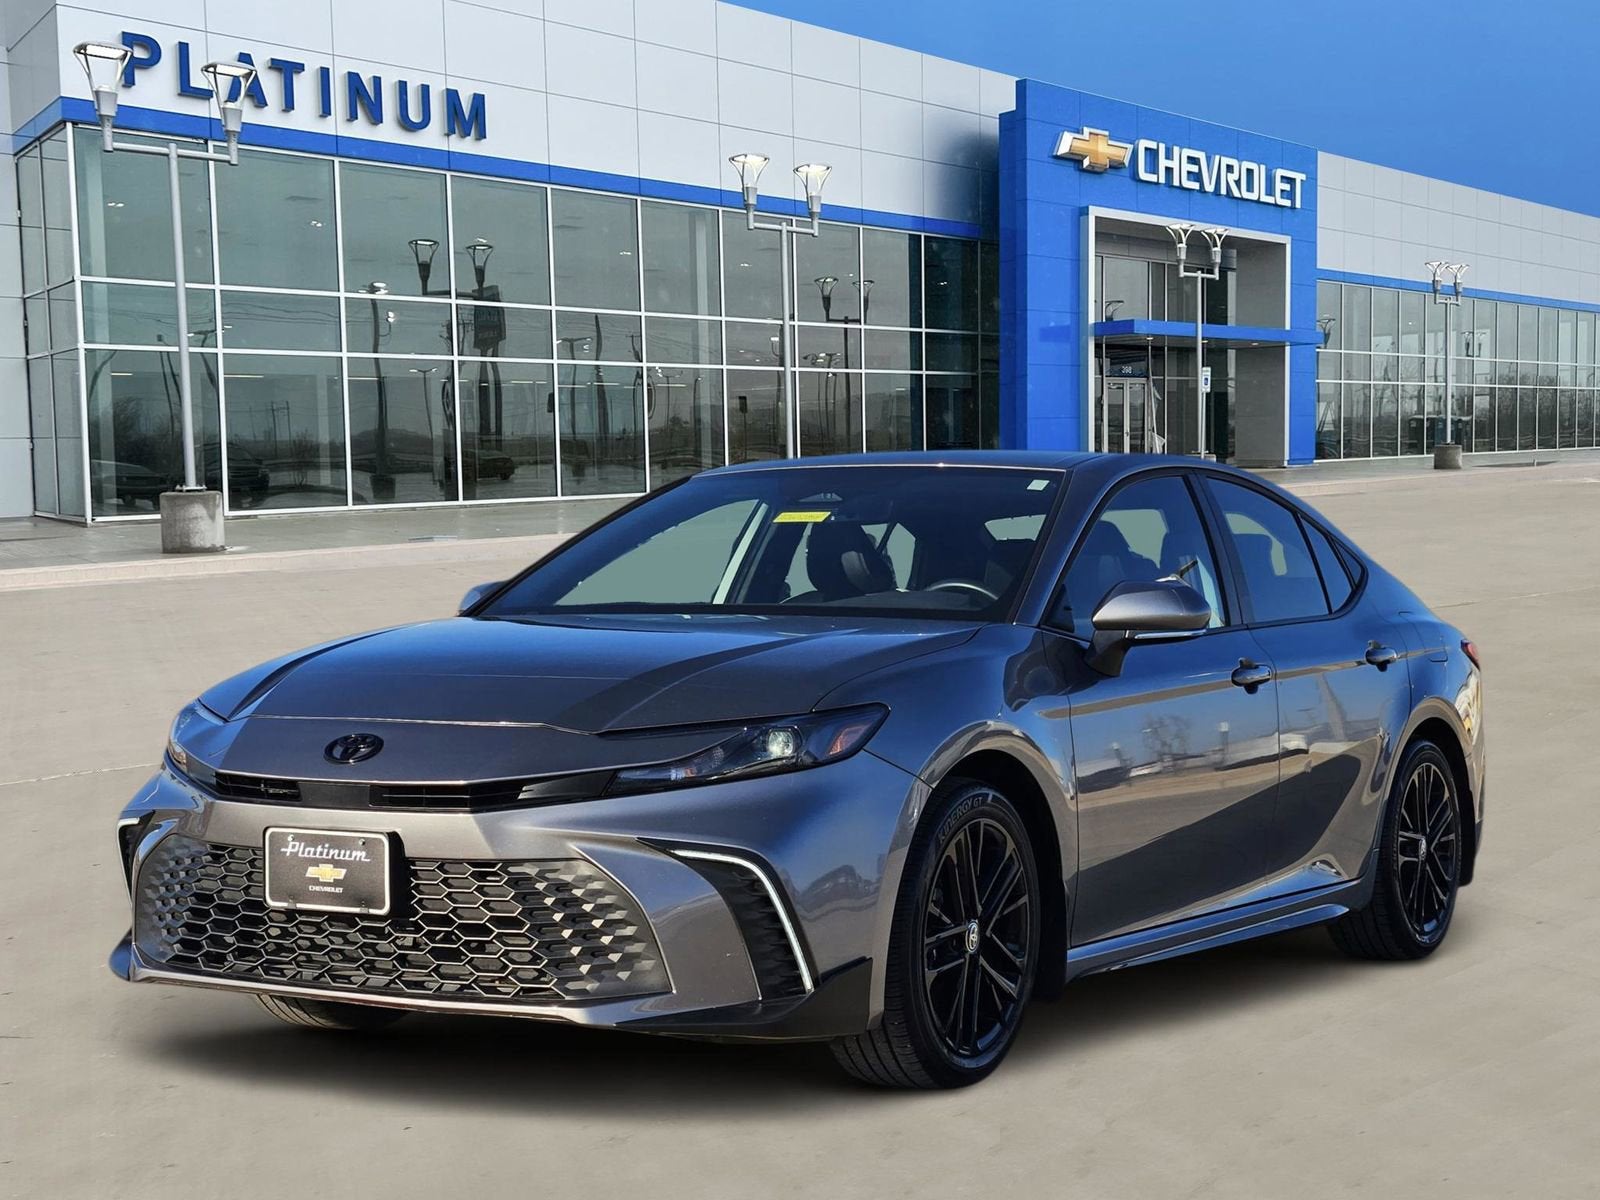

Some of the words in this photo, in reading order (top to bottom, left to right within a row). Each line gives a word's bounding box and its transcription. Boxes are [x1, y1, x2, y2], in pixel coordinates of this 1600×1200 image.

[121, 31, 487, 140] PLATINUM
[1137, 138, 1307, 209] CHEVROLET
[973, 796, 983, 808] GT
[281, 841, 371, 862] Platinum
[308, 885, 344, 893] CHEVROLET
